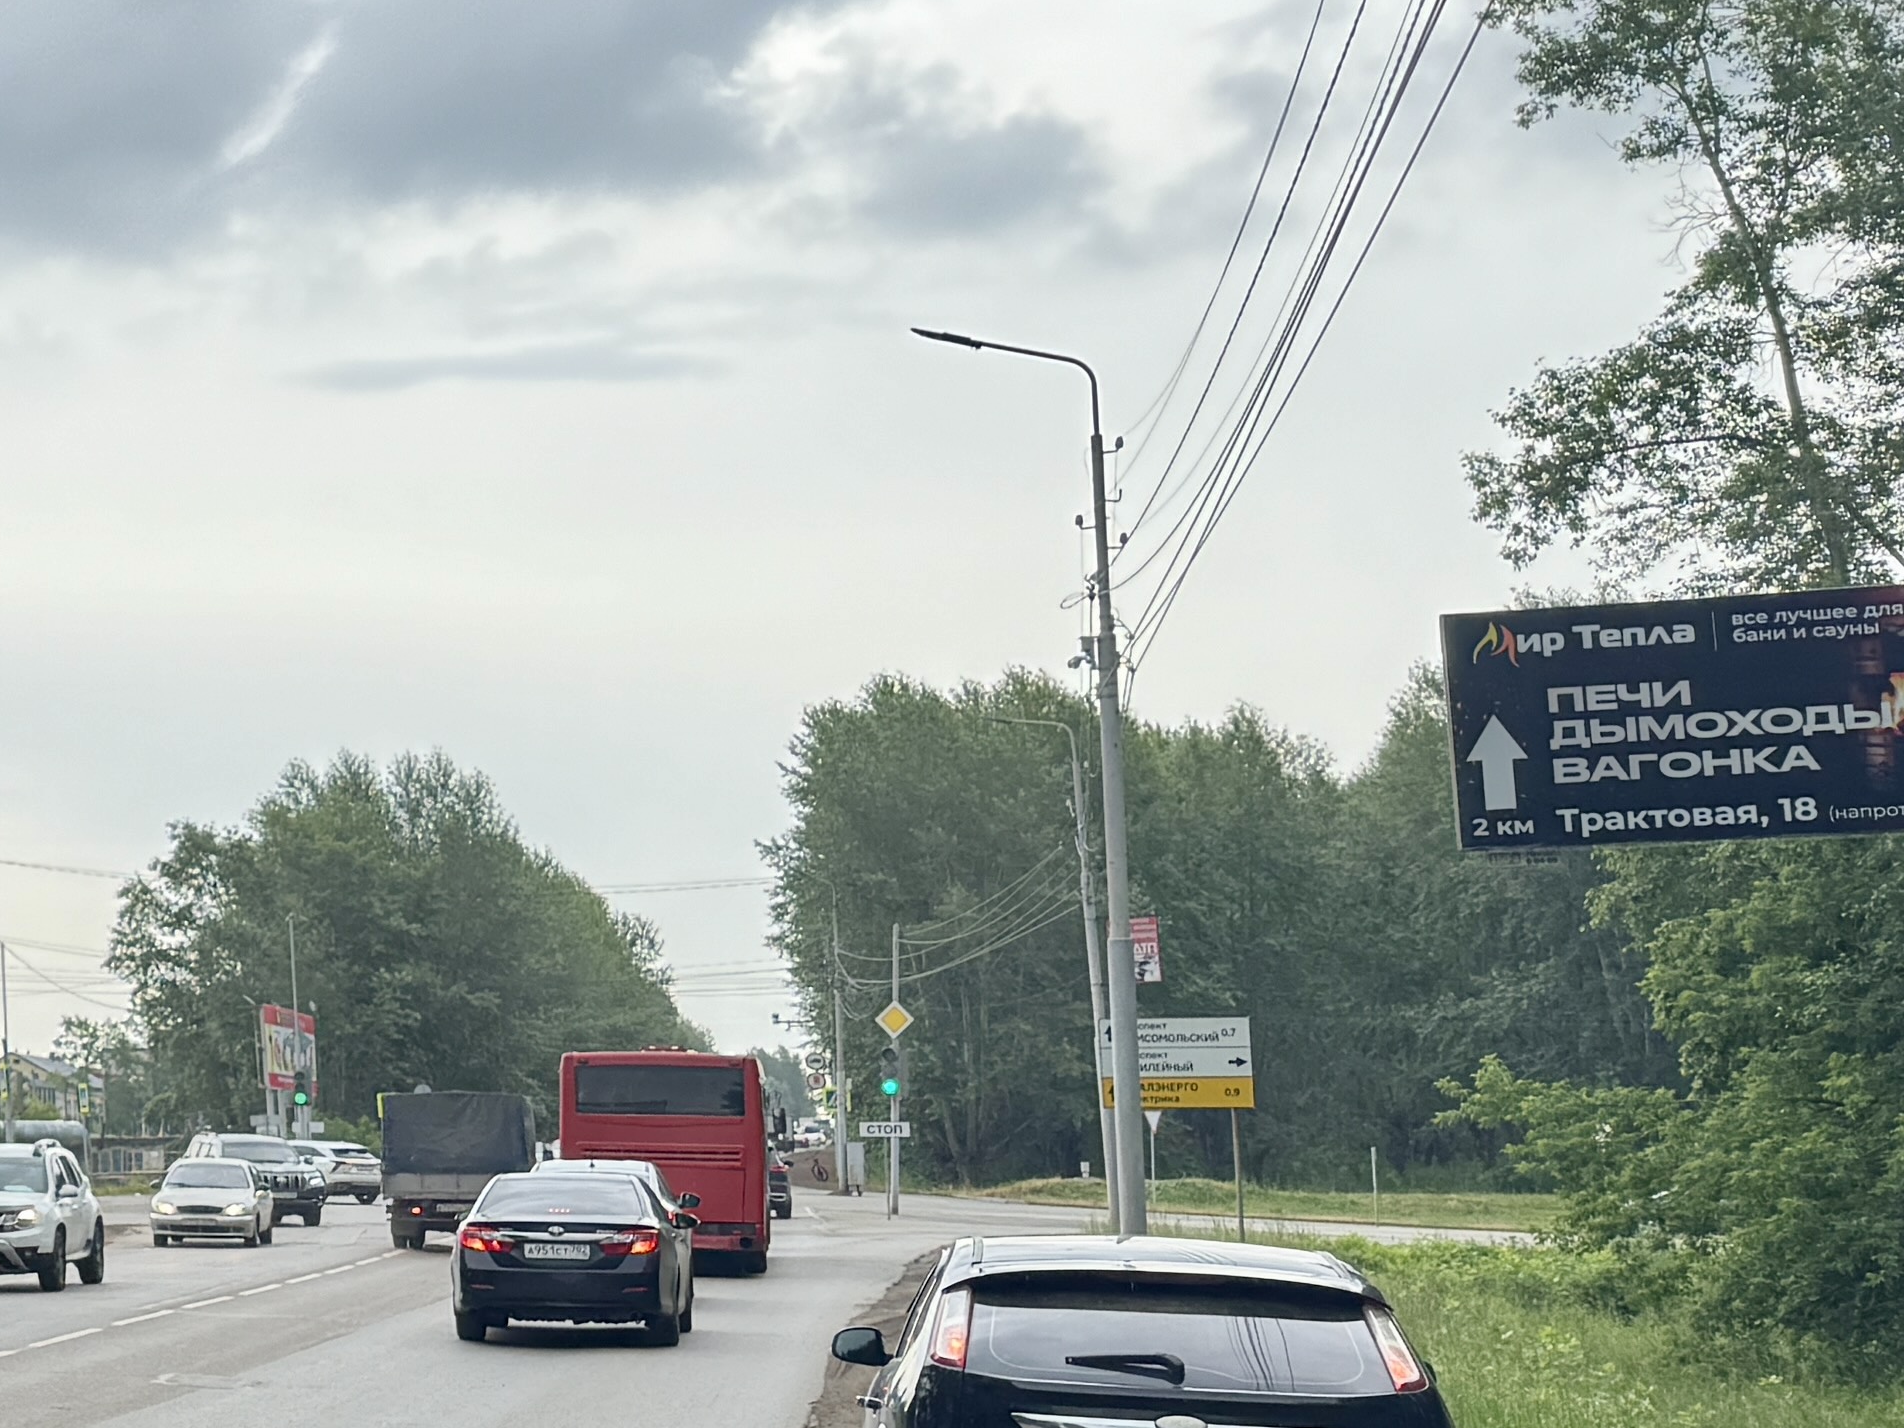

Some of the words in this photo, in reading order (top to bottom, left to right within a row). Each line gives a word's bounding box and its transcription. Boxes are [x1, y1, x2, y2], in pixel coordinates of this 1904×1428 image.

[1731, 612, 1769, 626] все
[1774, 606, 1858, 625] лучшее
[1863, 603, 1904, 619] для
[1572, 624, 1696, 650] Тепла
[1732, 627, 1786, 643] бани
[1793, 627, 1806, 639] и
[1812, 622, 1880, 639] сауны
[1547, 680, 1692, 713] ПЕЧИ
[1550, 700, 1895, 750] ДЫМОХОДЫ
[1553, 745, 1821, 784] ВАГОНКА
[1472, 819, 1490, 837] 2
[1497, 818, 1534, 836] км
[1555, 803, 1769, 838] Трактовая,
[1777, 796, 1819, 822] 18
[866, 1124, 903, 1134] СТОП
